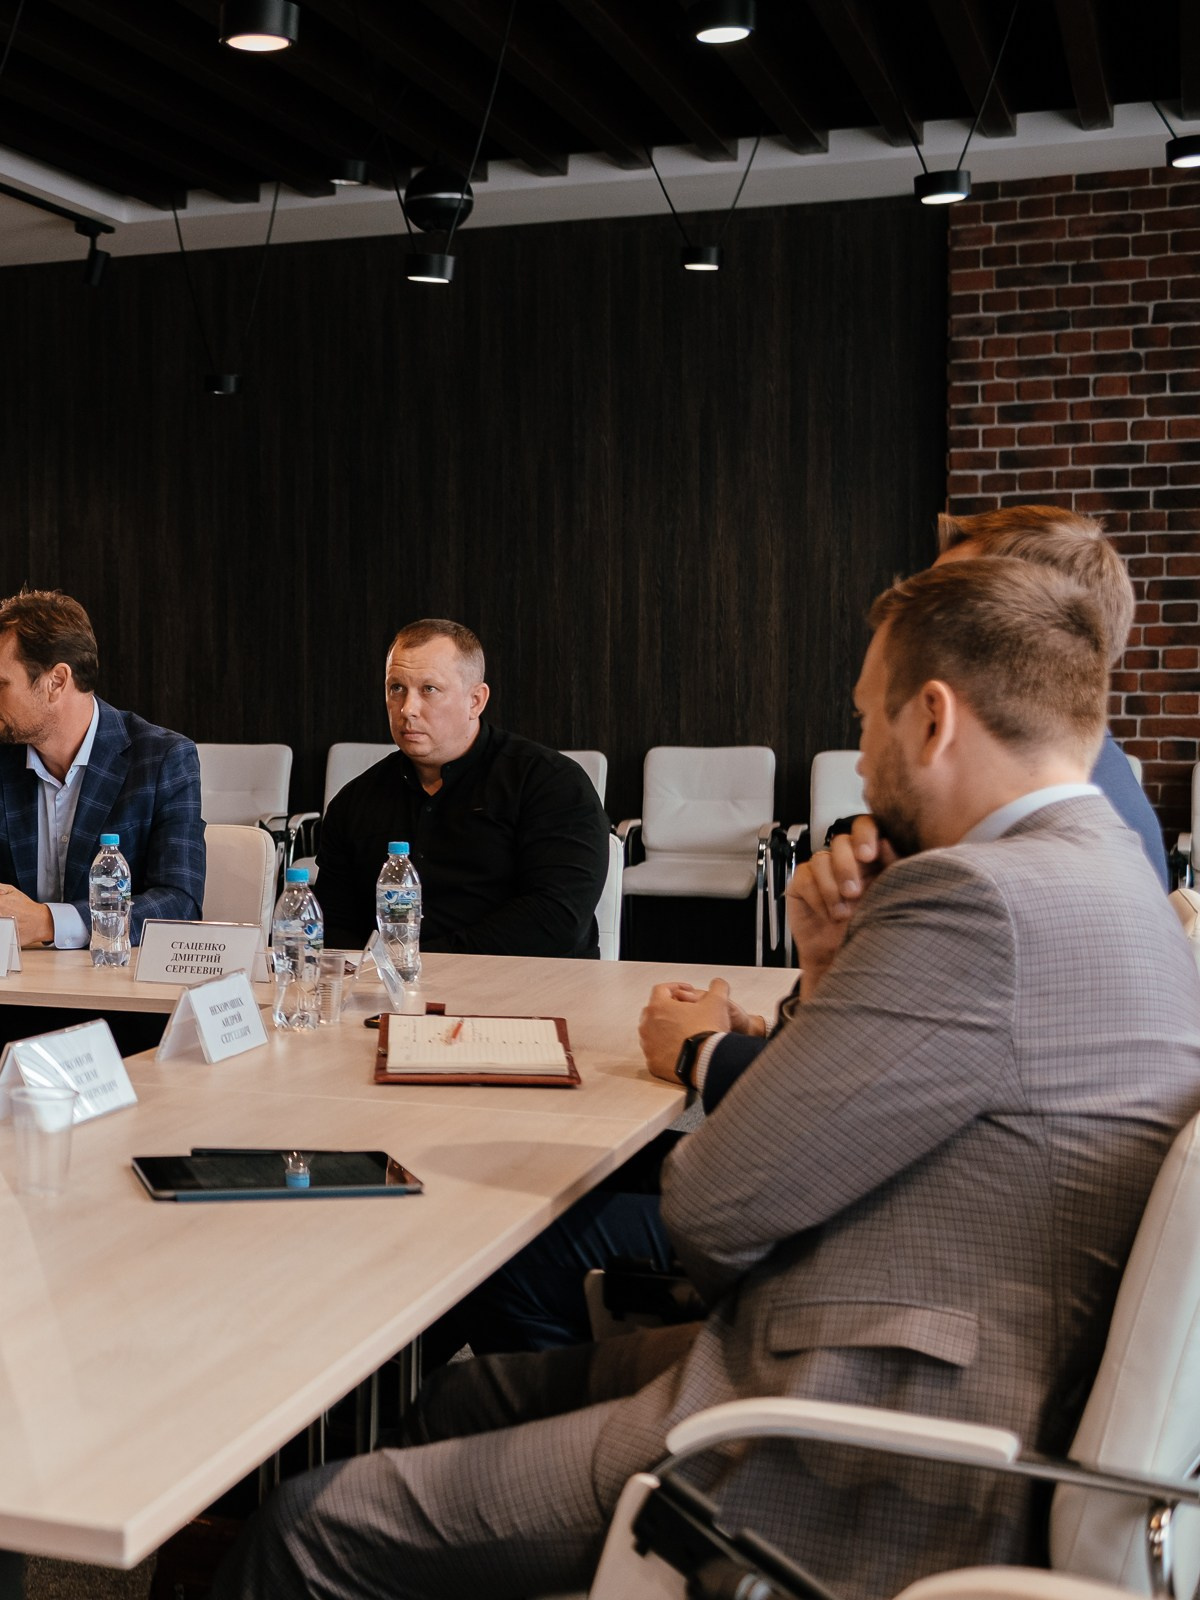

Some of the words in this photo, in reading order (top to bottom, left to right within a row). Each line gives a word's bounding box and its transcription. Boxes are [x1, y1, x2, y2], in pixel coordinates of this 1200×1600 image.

[170, 941, 226, 952] СТАЦЕНКО
[170, 952, 221, 963] ДМИТРИЙ
[165, 964, 223, 976] СЕРГЕЕВИЧ
